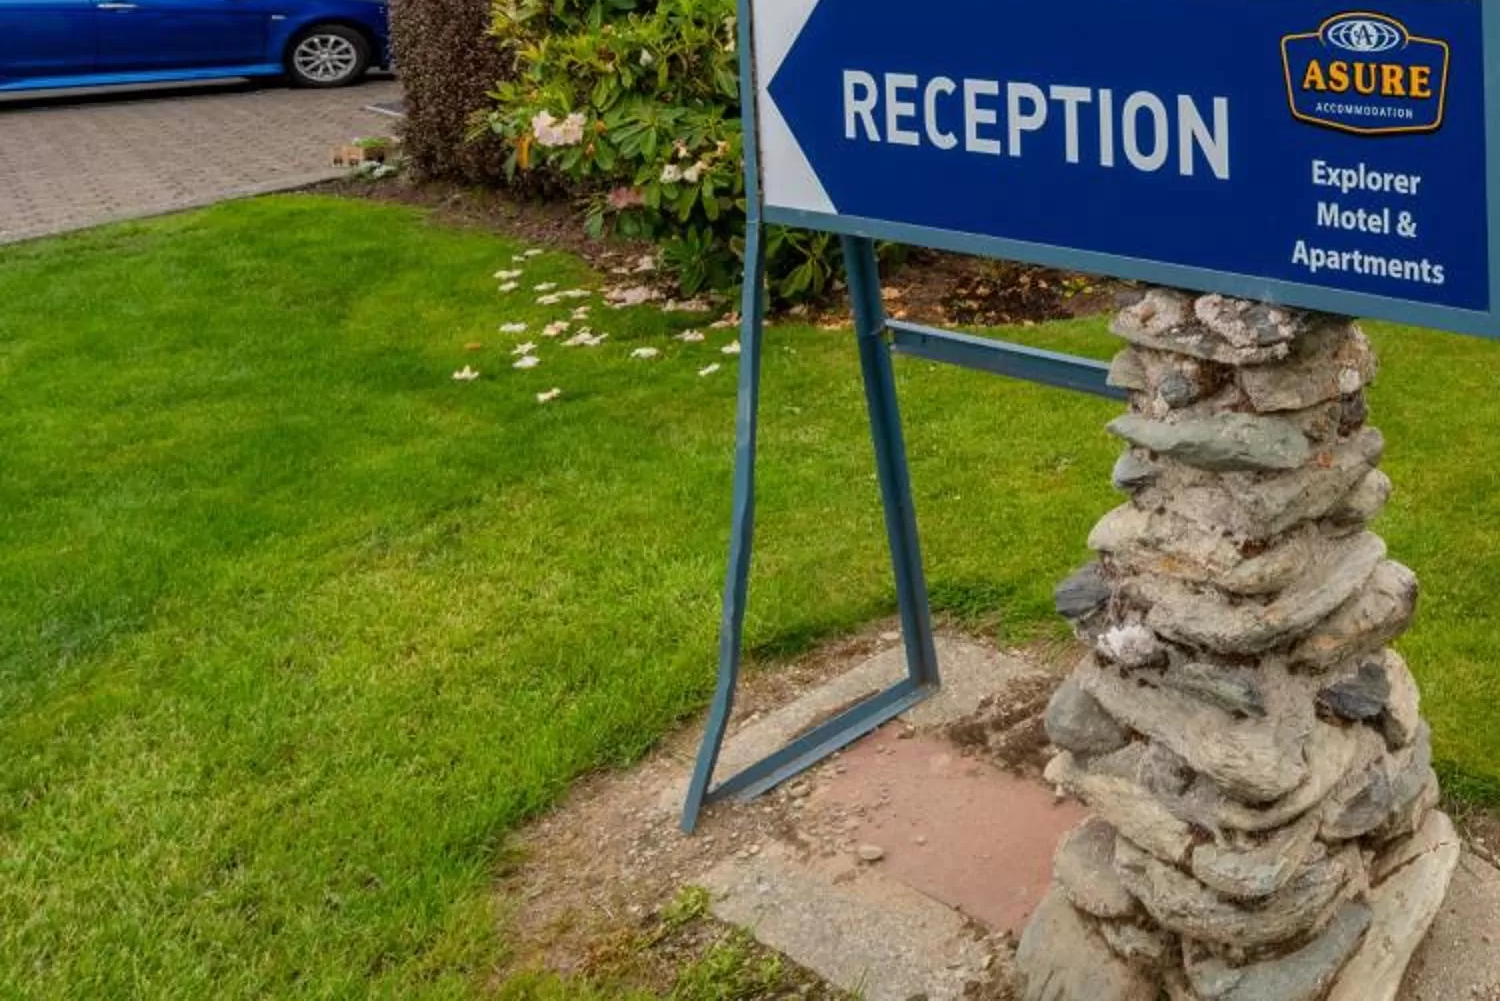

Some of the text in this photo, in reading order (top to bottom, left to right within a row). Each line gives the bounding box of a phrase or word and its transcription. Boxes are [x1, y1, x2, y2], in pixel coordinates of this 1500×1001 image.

[1303, 59, 1432, 98] ASURE
[843, 70, 1230, 180] RECEPTION
[1315, 102, 1414, 120] ACCOMMODATION
[1312, 159, 1421, 195] Explorer
[1317, 201, 1417, 238] Motel &
[1291, 240, 1445, 285] Apartments
